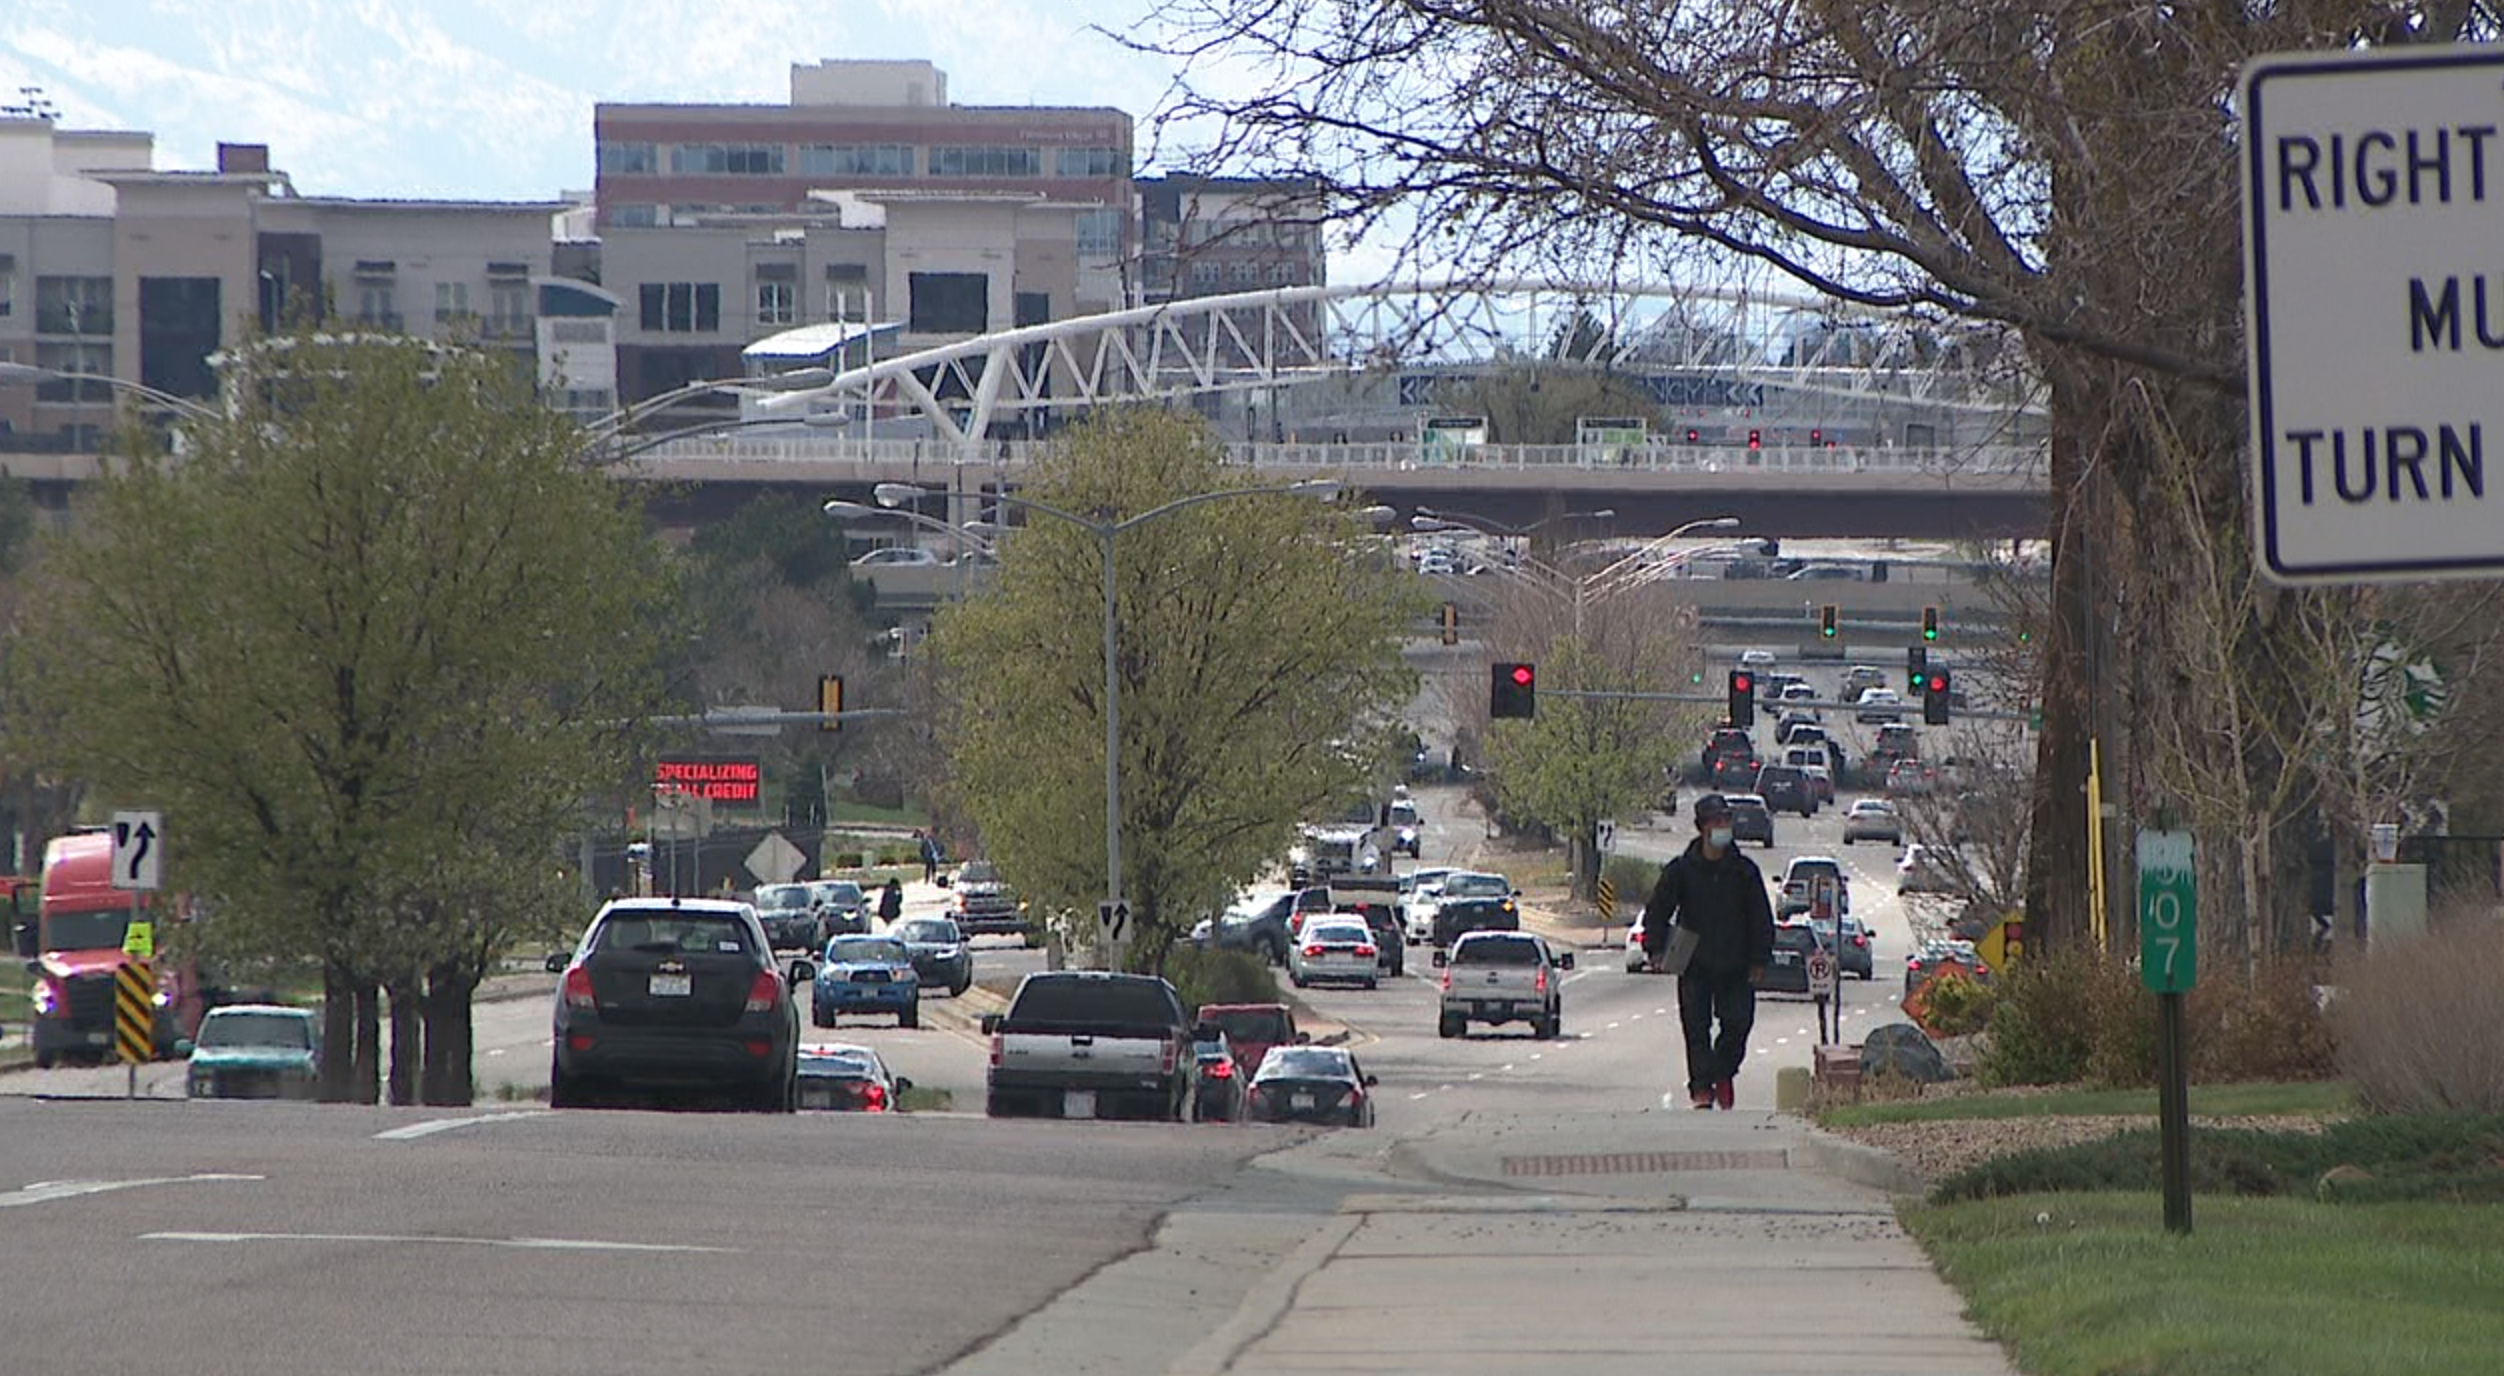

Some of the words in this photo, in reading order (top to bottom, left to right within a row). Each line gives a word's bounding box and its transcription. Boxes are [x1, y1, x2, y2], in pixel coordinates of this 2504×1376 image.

[2277, 125, 2497, 211] RIGHT
[2285, 422, 2485, 506] TURN
[657, 763, 758, 780] SPECIALIZING
[703, 783, 757, 799] CREDIT
